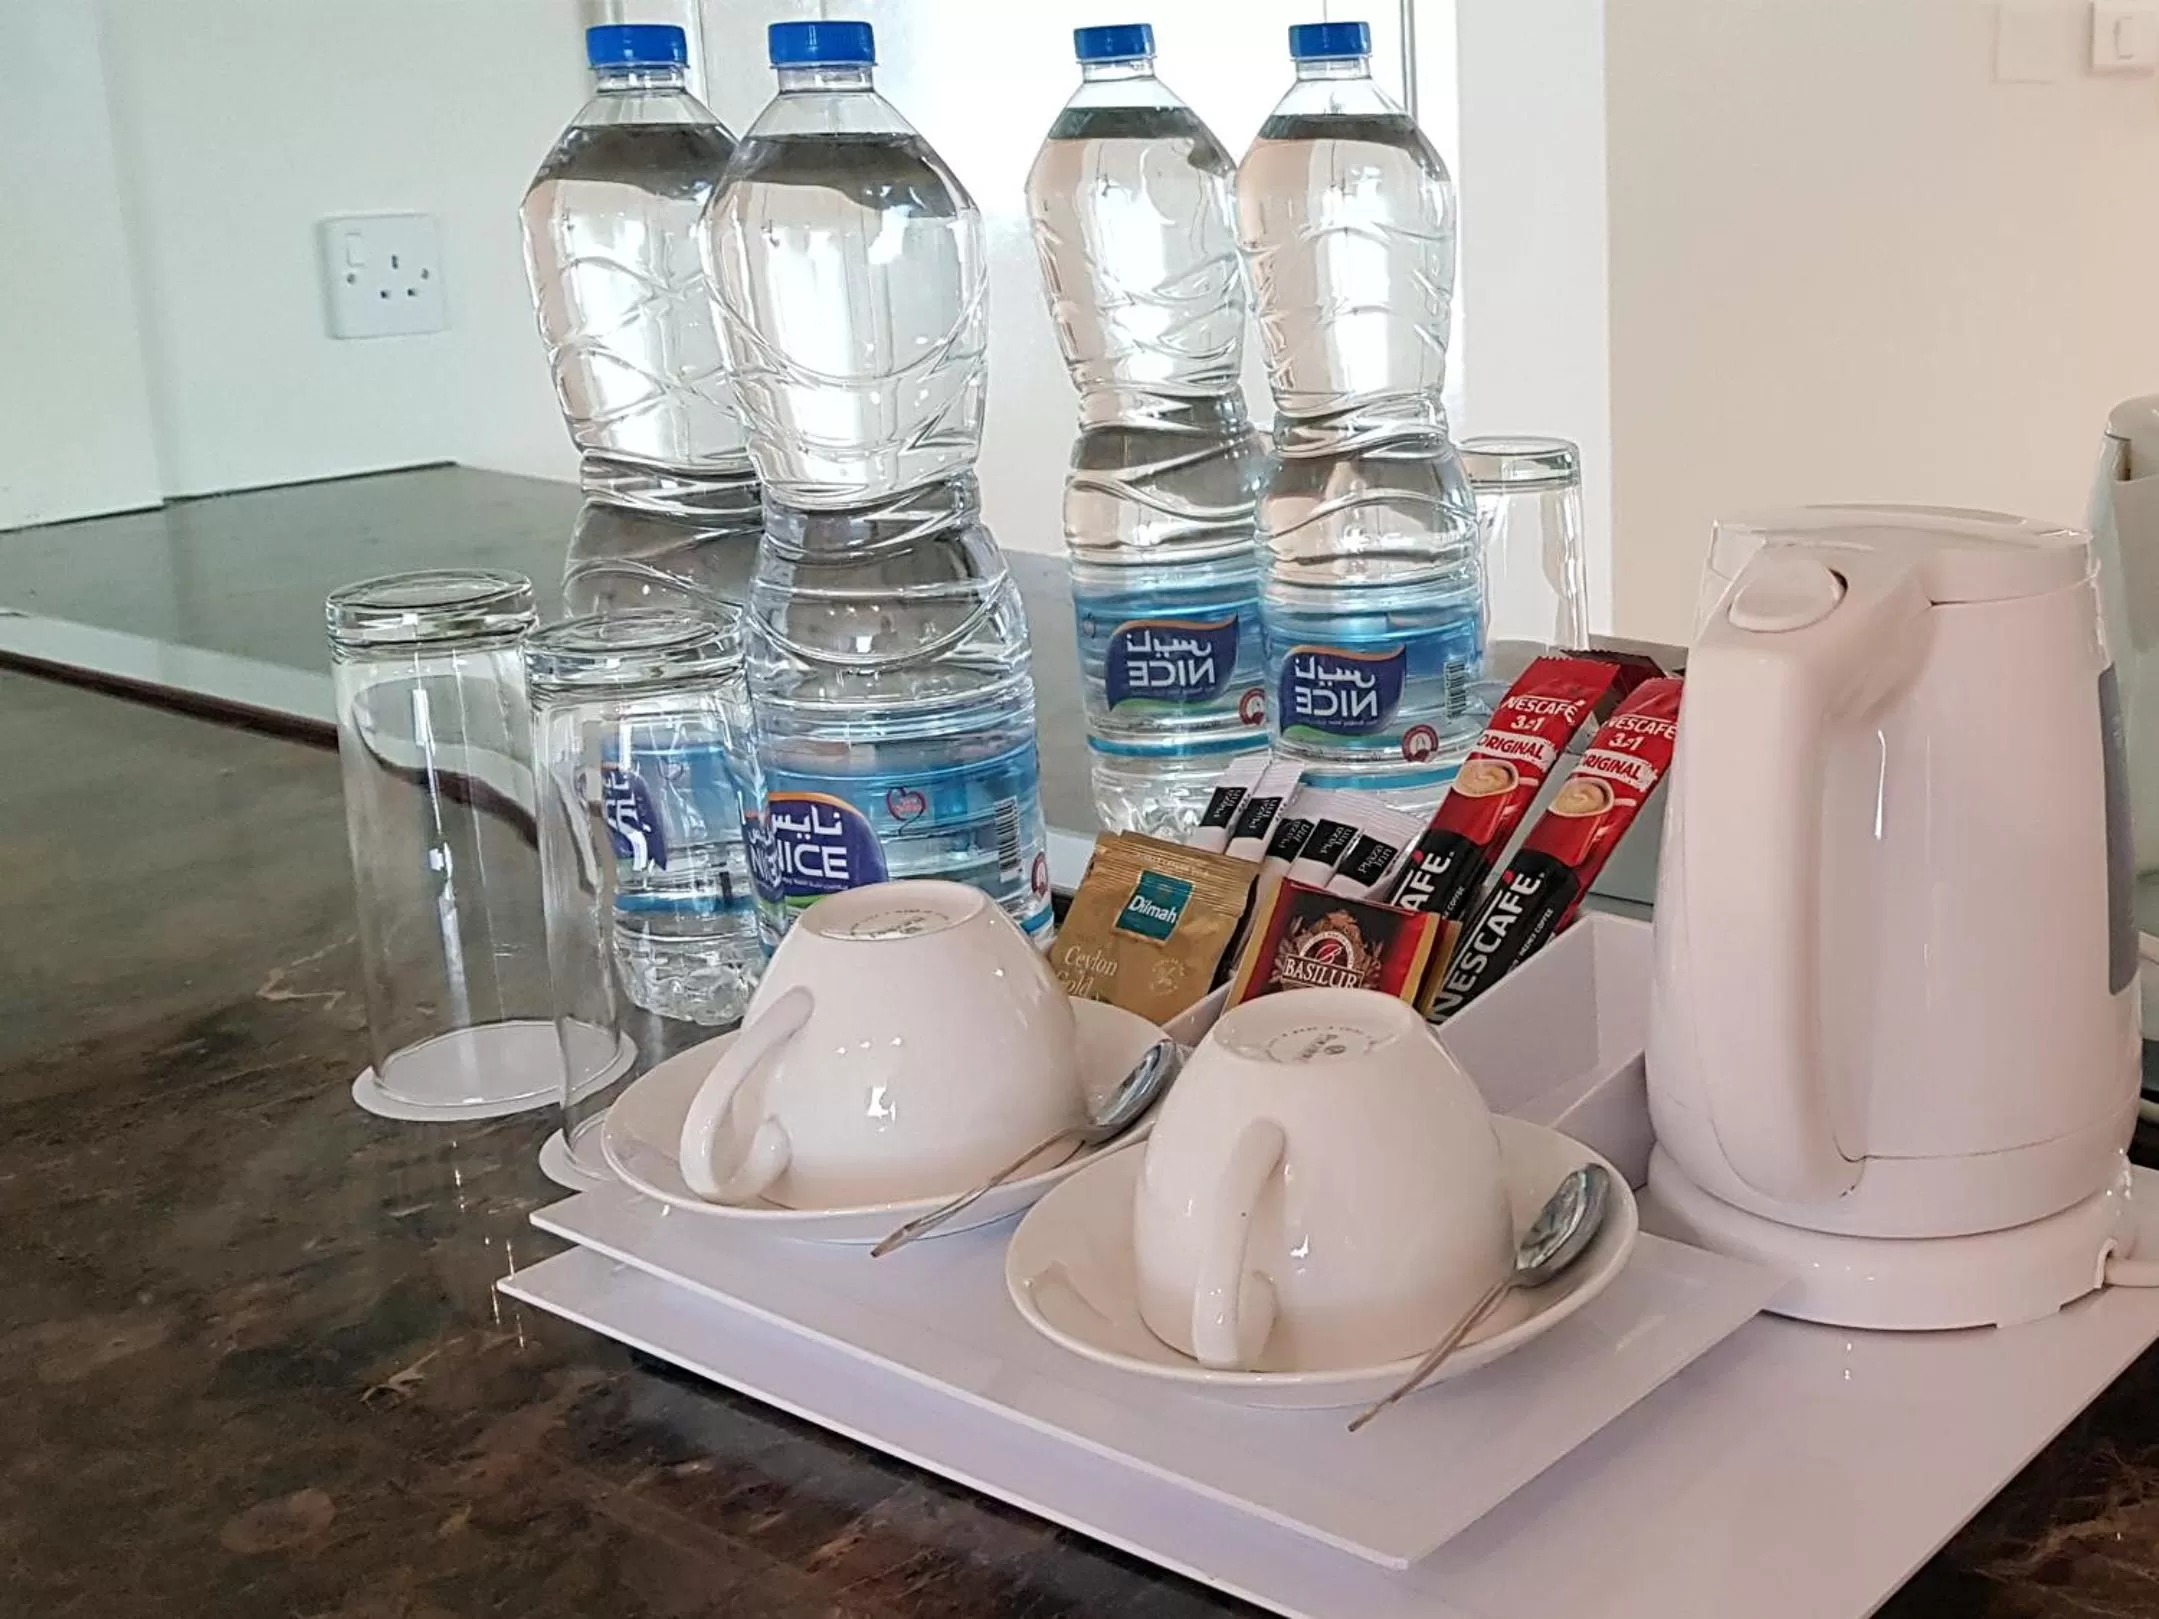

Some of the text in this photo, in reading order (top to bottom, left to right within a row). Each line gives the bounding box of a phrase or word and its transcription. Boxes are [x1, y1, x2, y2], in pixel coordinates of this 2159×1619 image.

[1476, 733, 1545, 761] ORIGINAL
[1128, 895, 1177, 924] Dilmah
[1065, 945, 1119, 976] Ceylon
[1284, 958, 1357, 988] BASILUR
